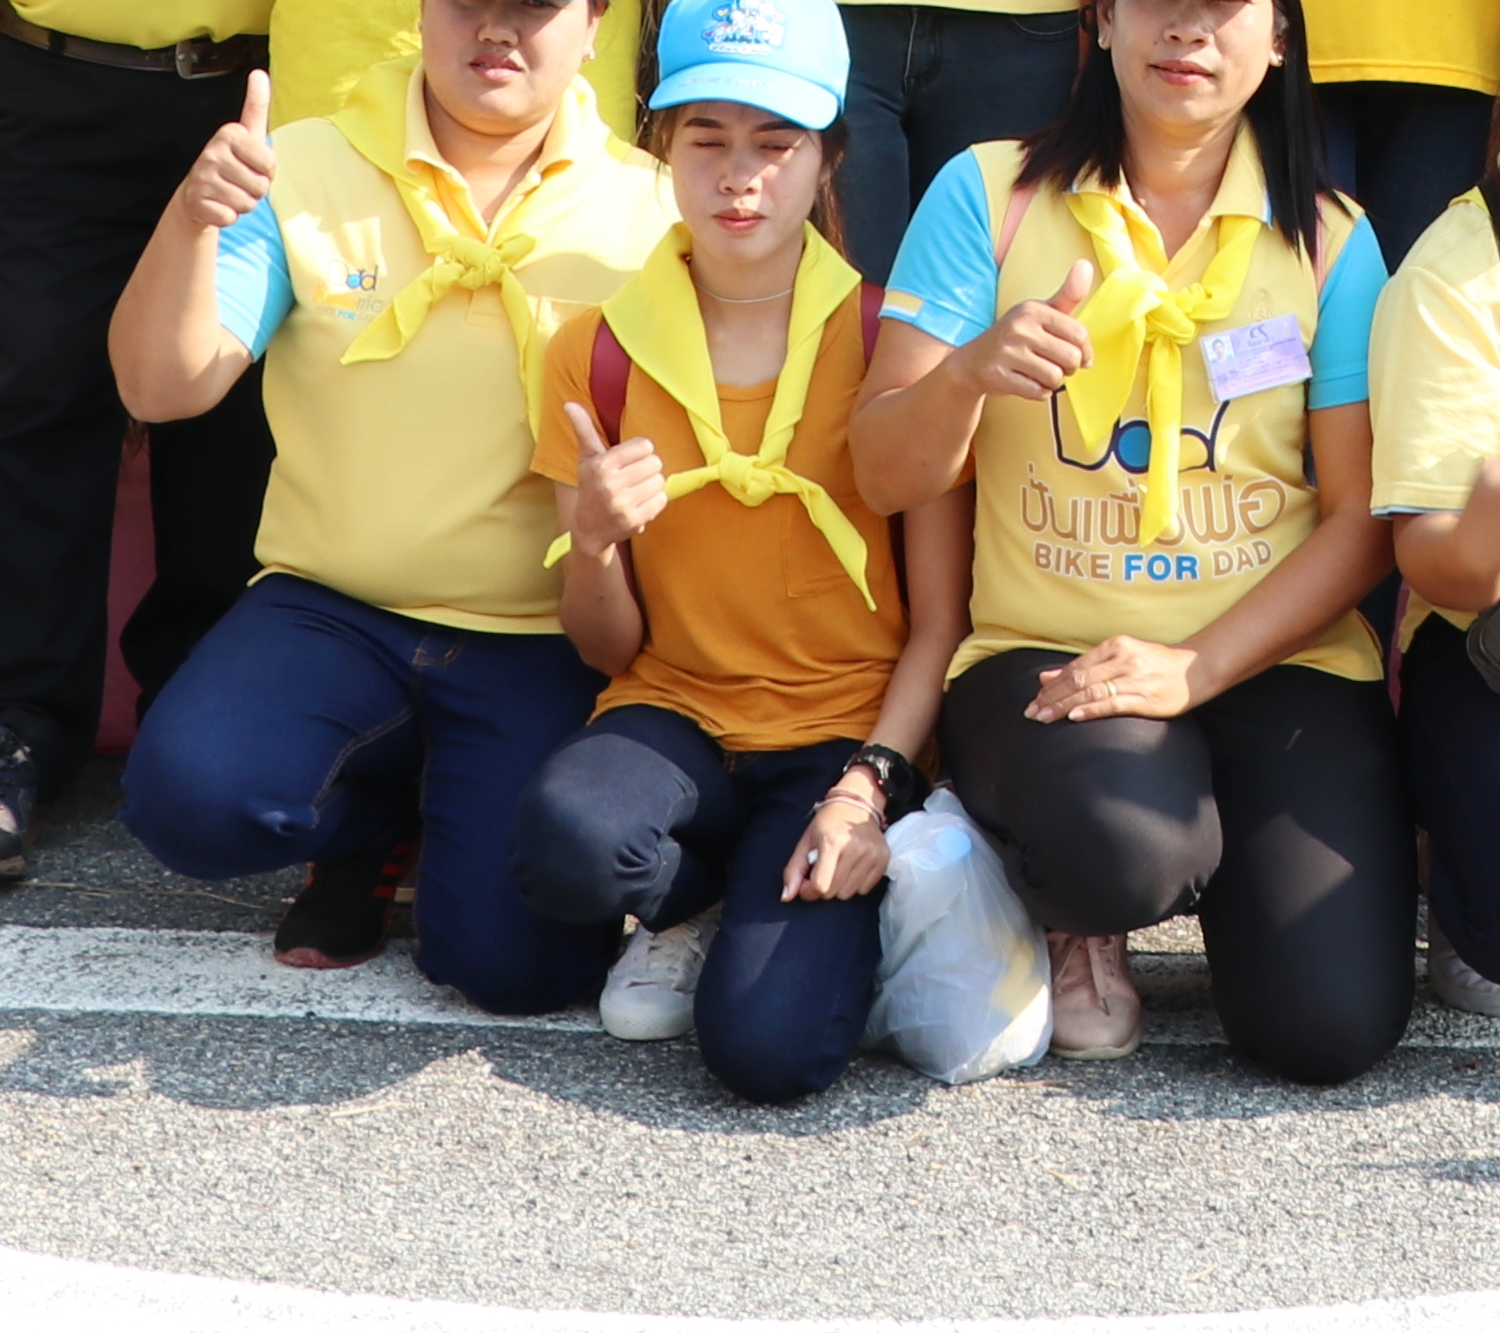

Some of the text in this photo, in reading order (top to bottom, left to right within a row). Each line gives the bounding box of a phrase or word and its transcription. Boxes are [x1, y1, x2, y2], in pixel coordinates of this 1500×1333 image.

[1033, 539, 1274, 582] BIKE FOR DAD
